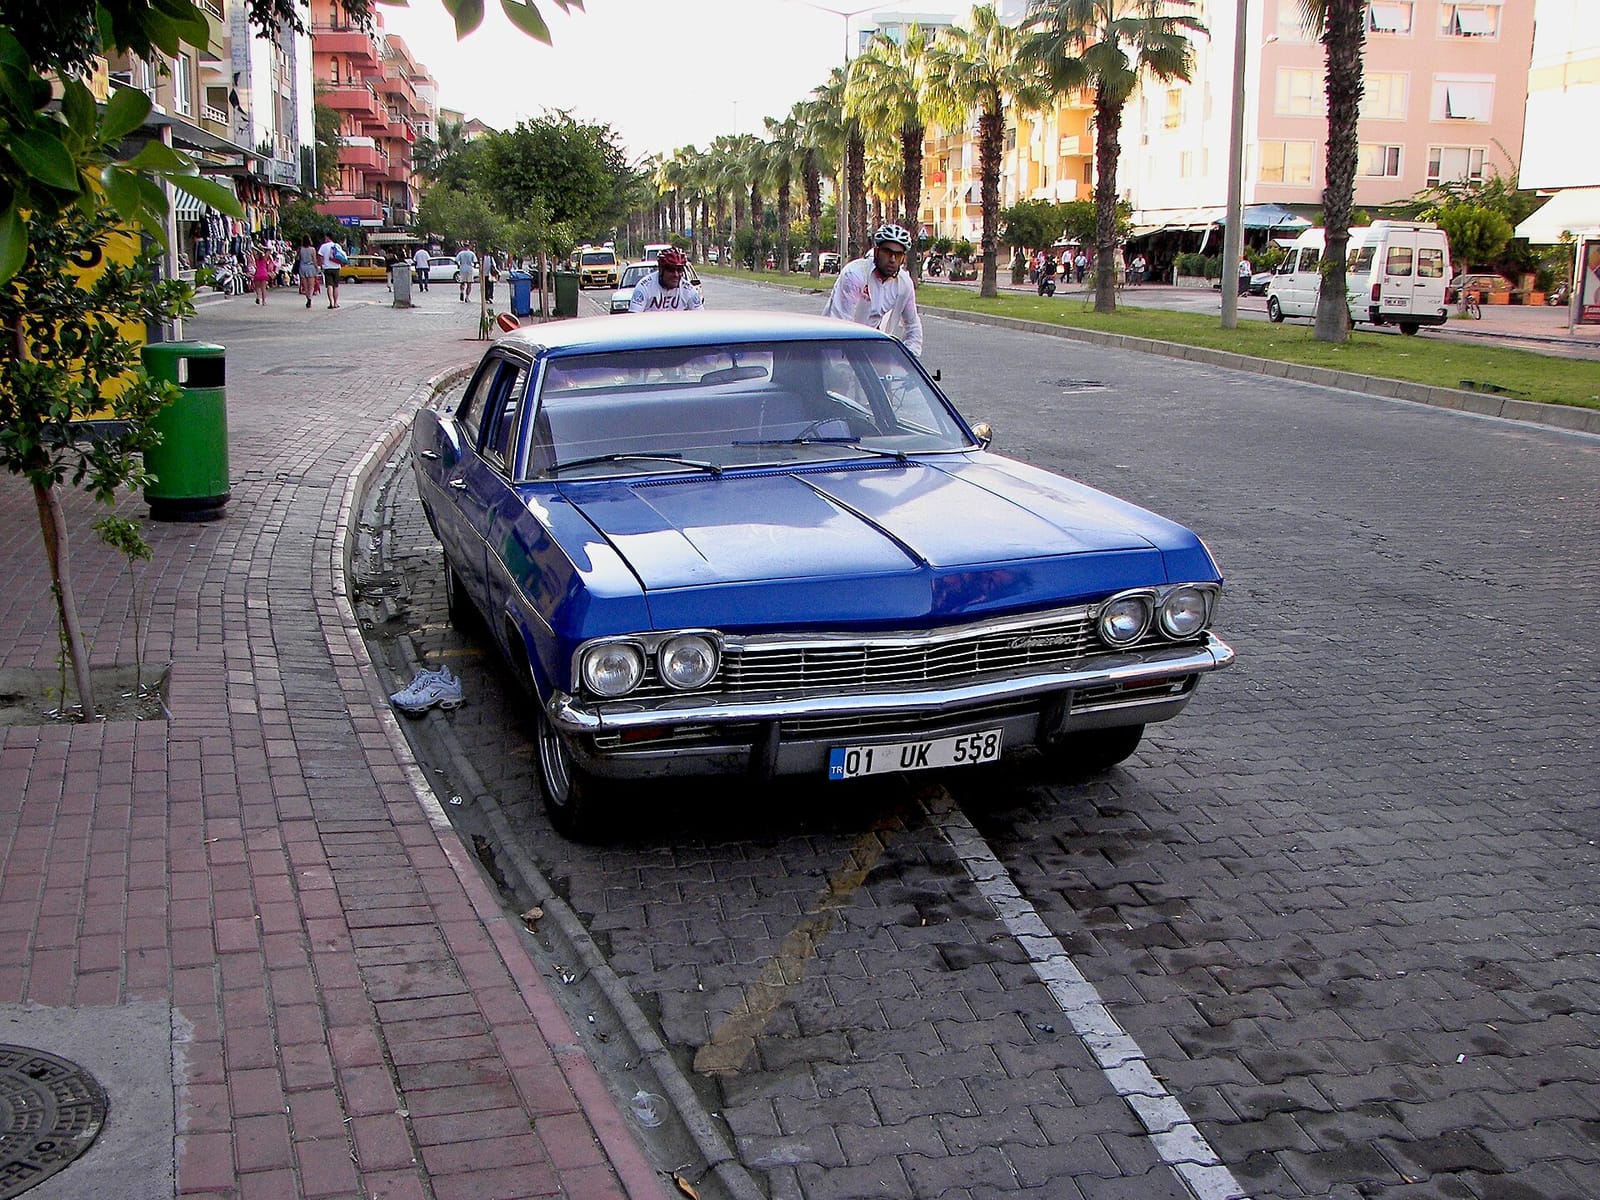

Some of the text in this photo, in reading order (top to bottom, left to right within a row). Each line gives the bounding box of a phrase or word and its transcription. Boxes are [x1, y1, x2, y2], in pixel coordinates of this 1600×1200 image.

[650, 293, 680, 309] NEU
[831, 734, 998, 775] TR 01 UK 558
